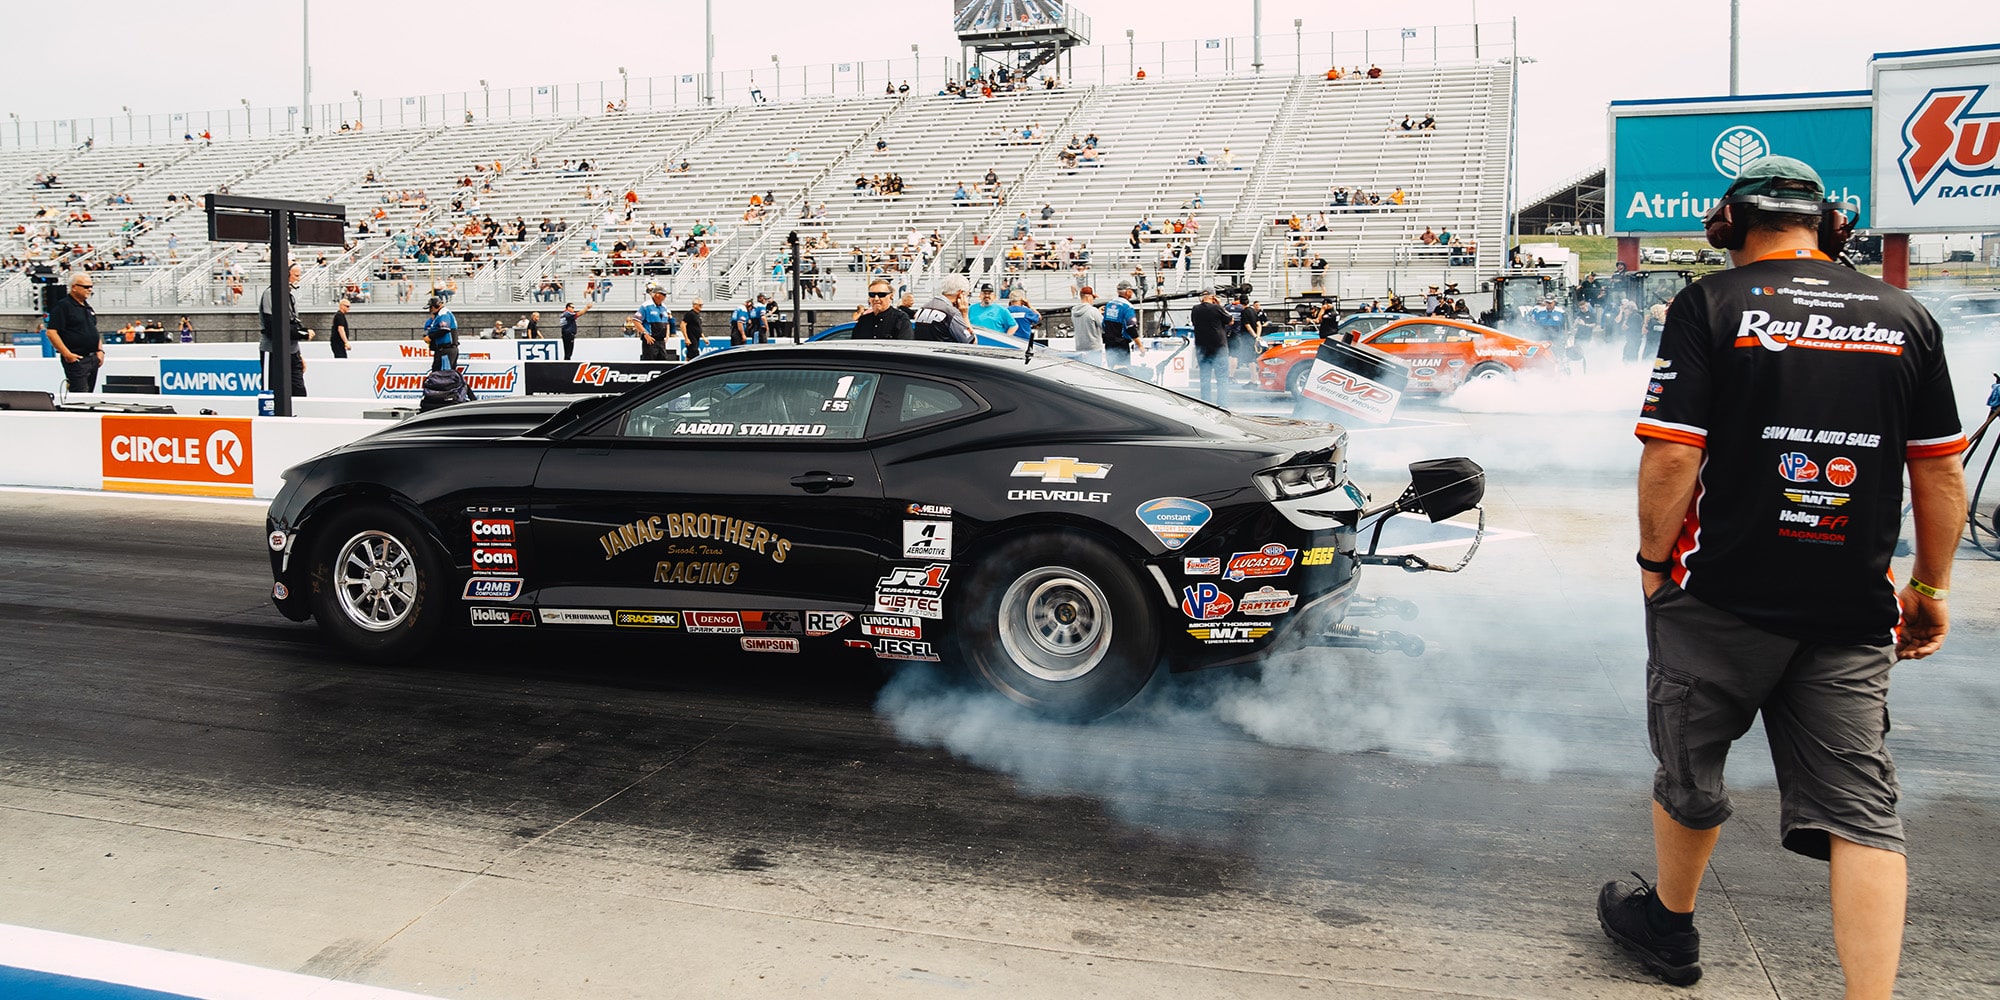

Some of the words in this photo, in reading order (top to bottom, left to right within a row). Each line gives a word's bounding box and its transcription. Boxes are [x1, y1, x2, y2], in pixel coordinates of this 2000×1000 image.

[1626, 191, 1721, 219] Atriu
[1777, 287, 1879, 301] @RayBartonRacingEngines
[1793, 297, 1844, 308] #RayBarton
[1737, 310, 1801, 351] Ray
[1802, 314, 1905, 345] Barton
[518, 342, 557, 360] FS1
[1795, 339, 1842, 350] RACING
[1844, 342, 1898, 353] ENGINES
[1475, 349, 1521, 358] Valvoline
[1410, 359, 1442, 367] LMAN
[163, 372, 237, 390] CAMPING
[834, 376, 855, 398] 1
[1318, 369, 1391, 403] FVP
[674, 423, 734, 435] AARON
[738, 424, 826, 436] STANFIELD
[1762, 426, 1788, 440] SAW
[1787, 428, 1812, 442] MILL
[1814, 430, 1846, 445] AUTO
[1845, 433, 1881, 448] SALES
[110, 435, 201, 465] CIRCLE
[1780, 452, 1807, 480] VP
[1831, 464, 1851, 472] NGK
[1008, 489, 1112, 503] CHEVROLET
[1801, 495, 1834, 505] M/T
[920, 504, 952, 514] MELLING
[1156, 513, 1191, 521] constant
[1779, 510, 1819, 527] Holley
[472, 520, 511, 535] Coan
[600, 515, 664, 561] JANAC
[666, 512, 792, 563] BROTHER'S
[1778, 528, 1845, 541] MAGNUSON
[473, 549, 513, 564] Coan
[699, 546, 723, 555] Texas
[906, 546, 946, 555] AEROMOTIVE
[1302, 547, 1335, 565] JEGS
[1233, 558, 1268, 568] LUCAS
[1270, 557, 1286, 566] OIL
[653, 560, 740, 585] RACING
[881, 567, 943, 587] JR1
[476, 582, 511, 592] LAMB
[922, 588, 938, 596] OIL
[878, 596, 938, 611] GIBTEC
[1183, 583, 1219, 619] VP
[1206, 601, 1233, 613] Racing
[1263, 600, 1290, 608] TECH
[472, 609, 509, 623] Holley
[629, 614, 676, 624] RACEPAK
[701, 615, 734, 624] DENSO
[908, 609, 938, 617] PISTONS
[864, 616, 911, 627] LINCOLN
[875, 626, 916, 637] WELDERS
[1210, 627, 1253, 639] M/T
[746, 640, 794, 650] SIMPSON
[875, 639, 935, 657] JESEL
